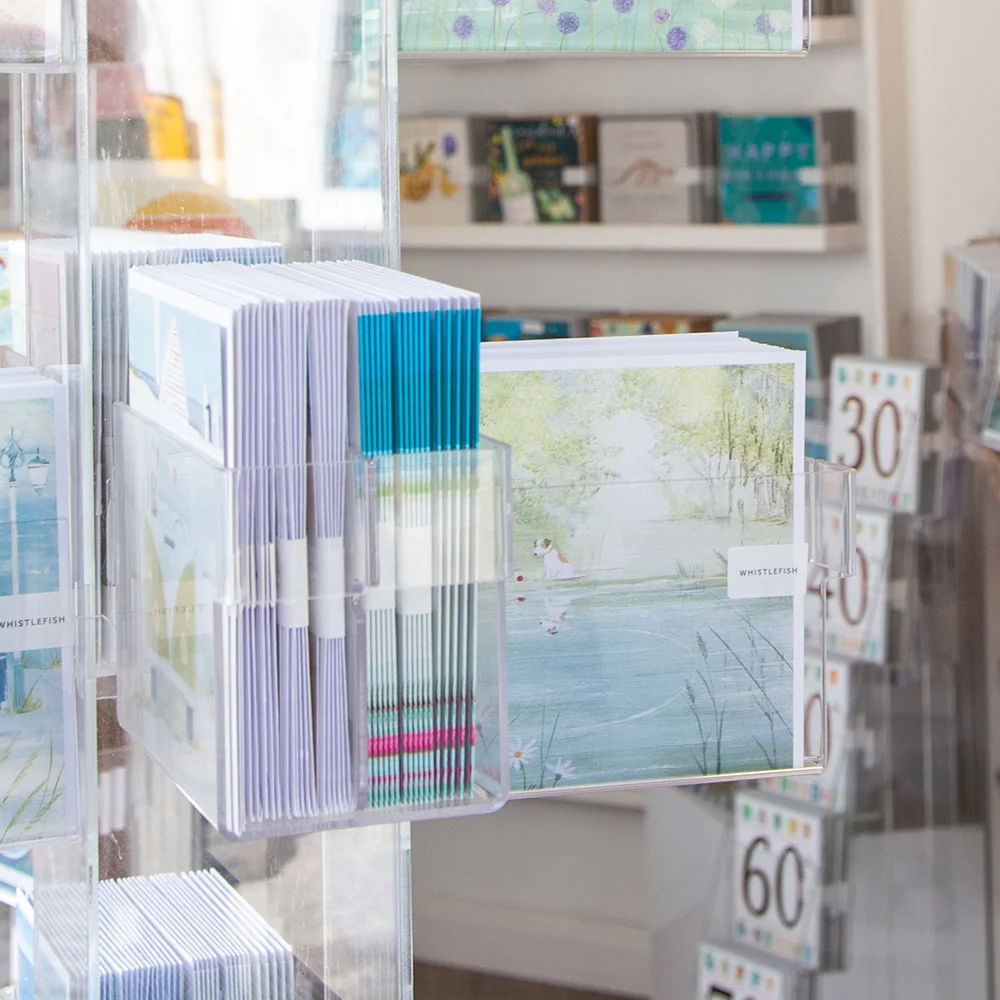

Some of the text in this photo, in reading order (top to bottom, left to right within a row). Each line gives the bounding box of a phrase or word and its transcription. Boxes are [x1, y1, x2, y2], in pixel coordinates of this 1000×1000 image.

[839, 393, 903, 479] 30
[739, 567, 798, 577] WHISTLEFISH
[0, 616, 66, 629] WHISTLEFISH
[742, 835, 805, 929] 60
